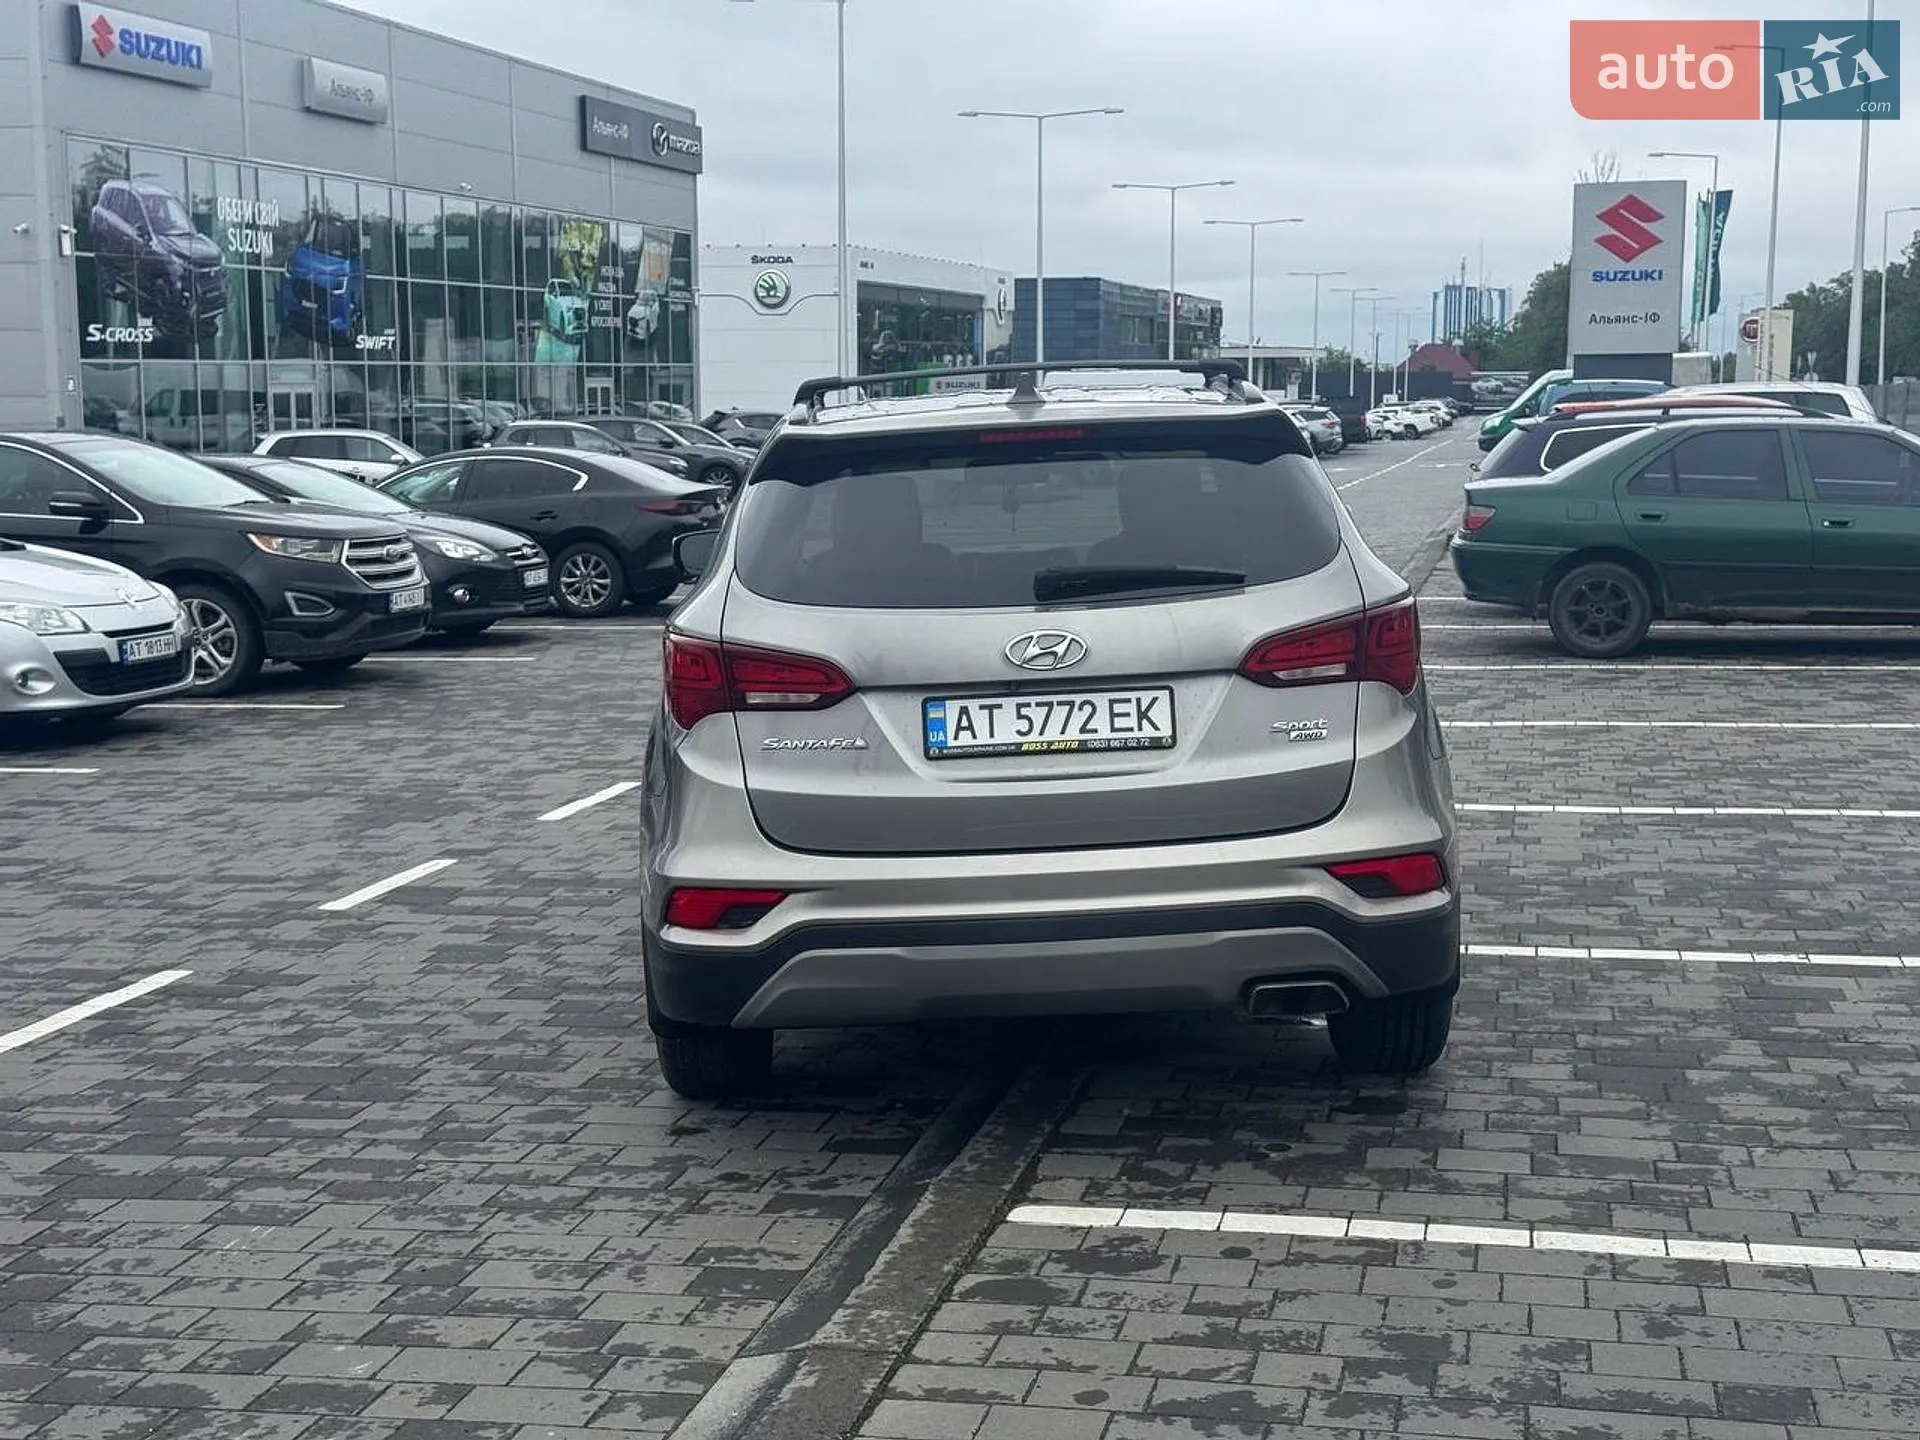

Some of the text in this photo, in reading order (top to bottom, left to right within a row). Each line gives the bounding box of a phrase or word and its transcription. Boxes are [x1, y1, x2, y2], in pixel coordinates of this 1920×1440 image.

[118, 27, 203, 71] SUZUKI
[227, 227, 273, 258] SUZUKI
[1591, 269, 1664, 282] SUZUKI
[355, 334, 396, 349] SWIFT
[129, 640, 142, 658] AT
[953, 696, 1160, 741] AT 5772 EK
[1269, 718, 1328, 732] Sport
[930, 732, 946, 742] UA
[1293, 731, 1324, 740] AWD
[1050, 740, 1079, 750] AUTO
[1140, 738, 1150, 746] 72
